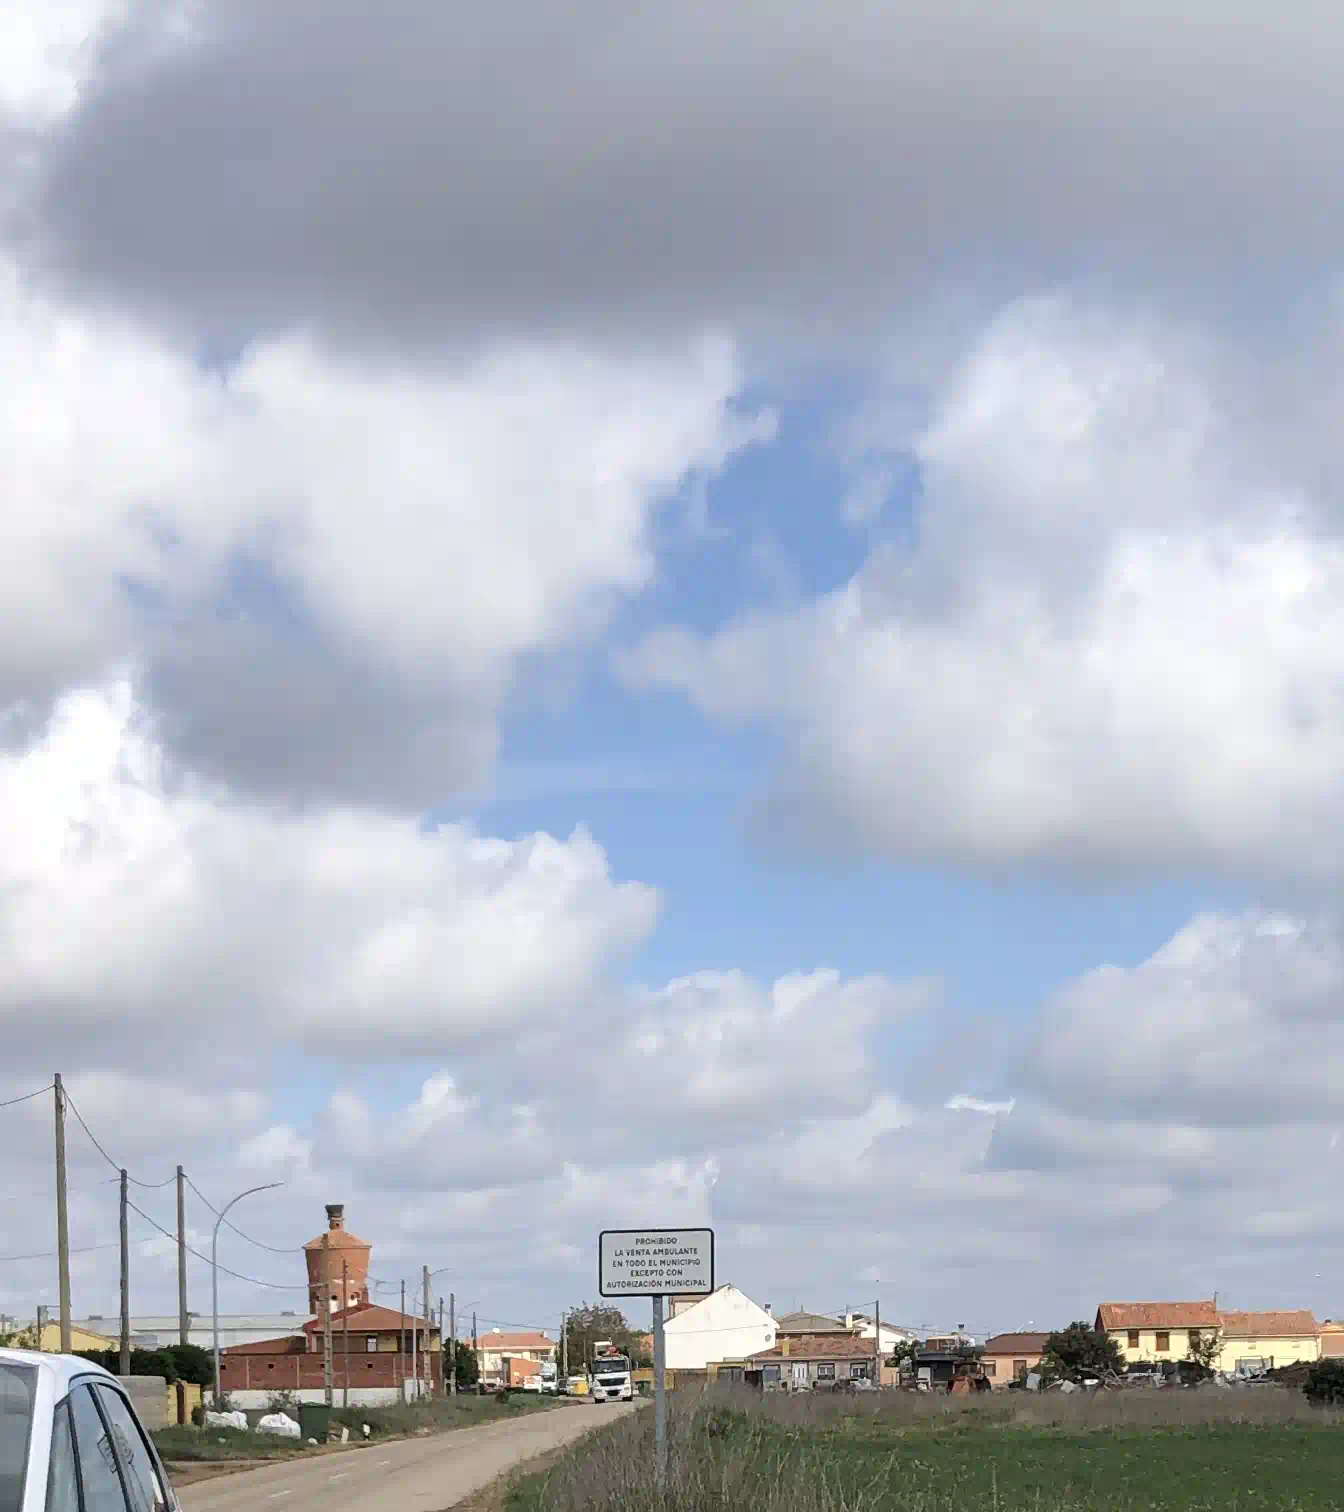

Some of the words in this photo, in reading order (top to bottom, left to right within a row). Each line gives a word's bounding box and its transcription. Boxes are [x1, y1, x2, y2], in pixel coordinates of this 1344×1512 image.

[635, 1237, 677, 1245] PROHIBIDO
[614, 1249, 624, 1257] LA
[652, 1248, 698, 1256] AMBULANTE
[612, 1260, 624, 1268] EN
[664, 1279, 706, 1287] MUNICIPAL
